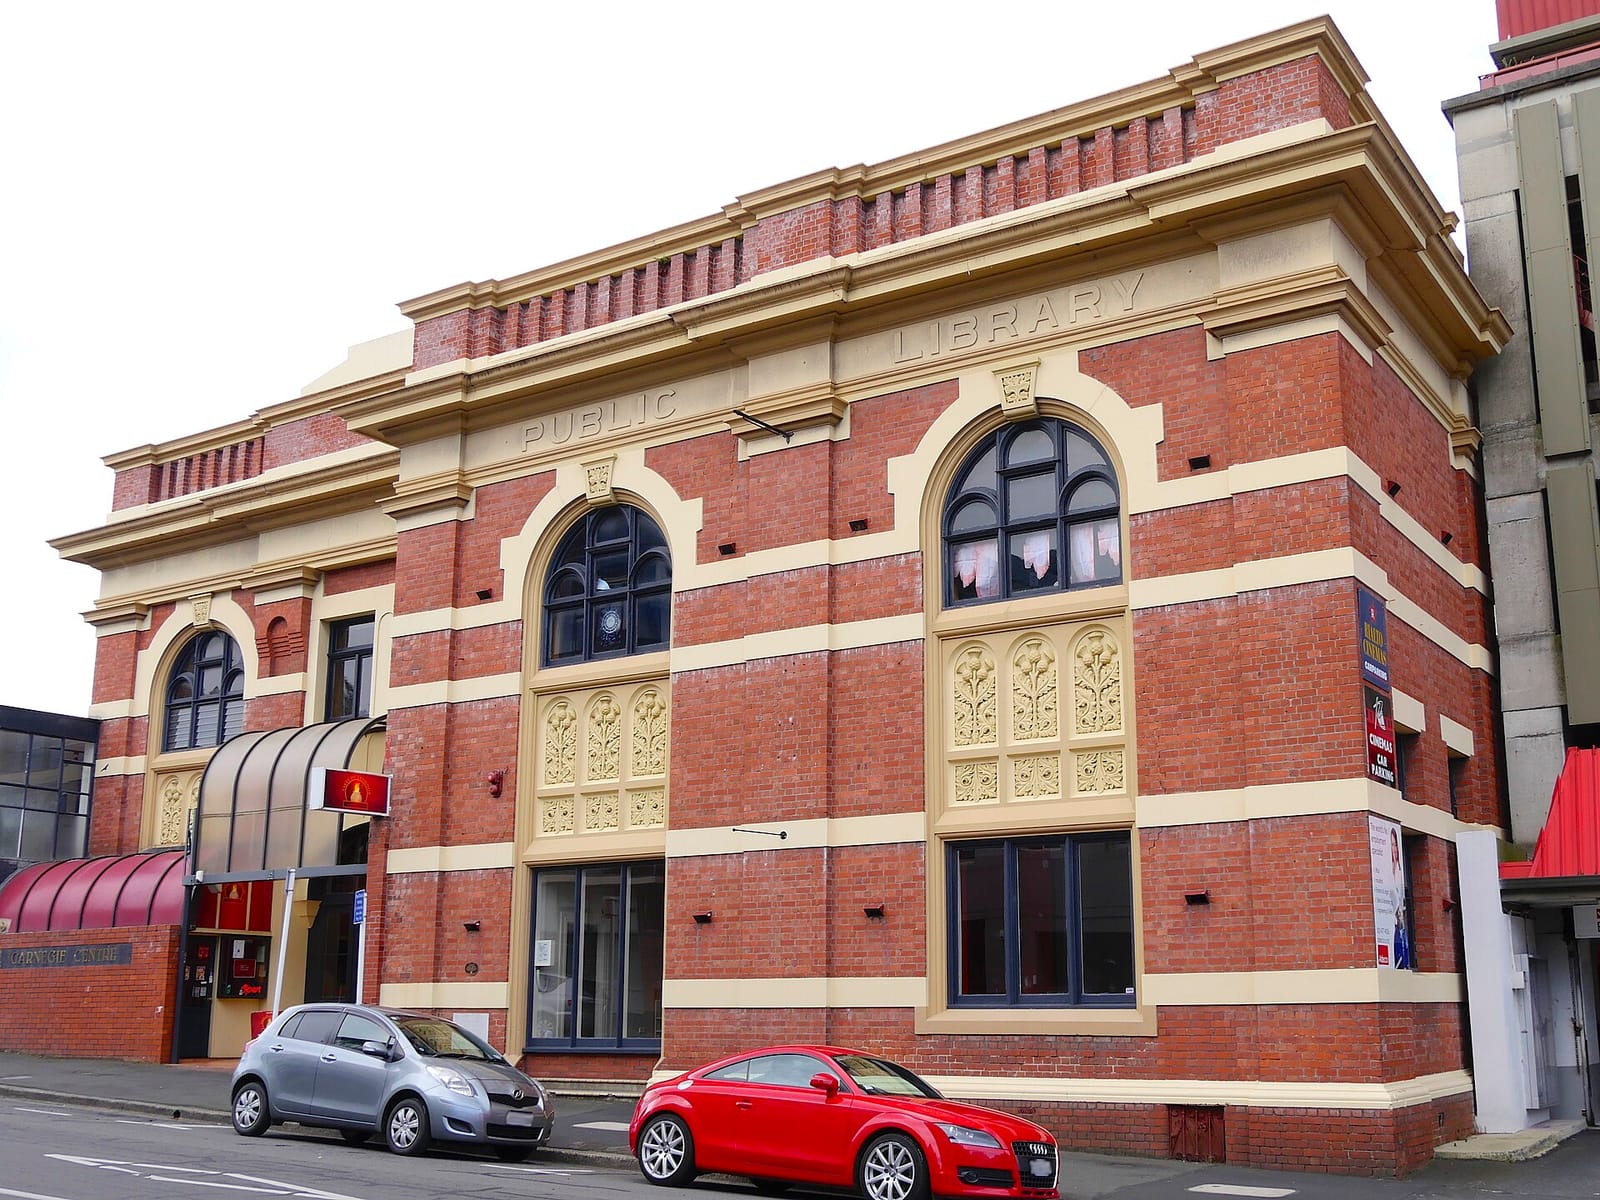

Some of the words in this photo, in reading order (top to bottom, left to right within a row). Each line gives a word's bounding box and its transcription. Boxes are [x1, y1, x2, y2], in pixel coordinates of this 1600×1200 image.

[893, 271, 1145, 364] LIBRARY
[521, 388, 677, 453] PUBLIC
[1364, 622, 1384, 647] RIALTO
[1362, 638, 1388, 667] CINEMAS
[1369, 733, 1393, 754] CINEMAS
[1376, 753, 1388, 768] CAR
[1371, 763, 1394, 783] PARKING
[10, 950, 67, 965] CARNEGIE
[74, 947, 117, 962] CENTRE
